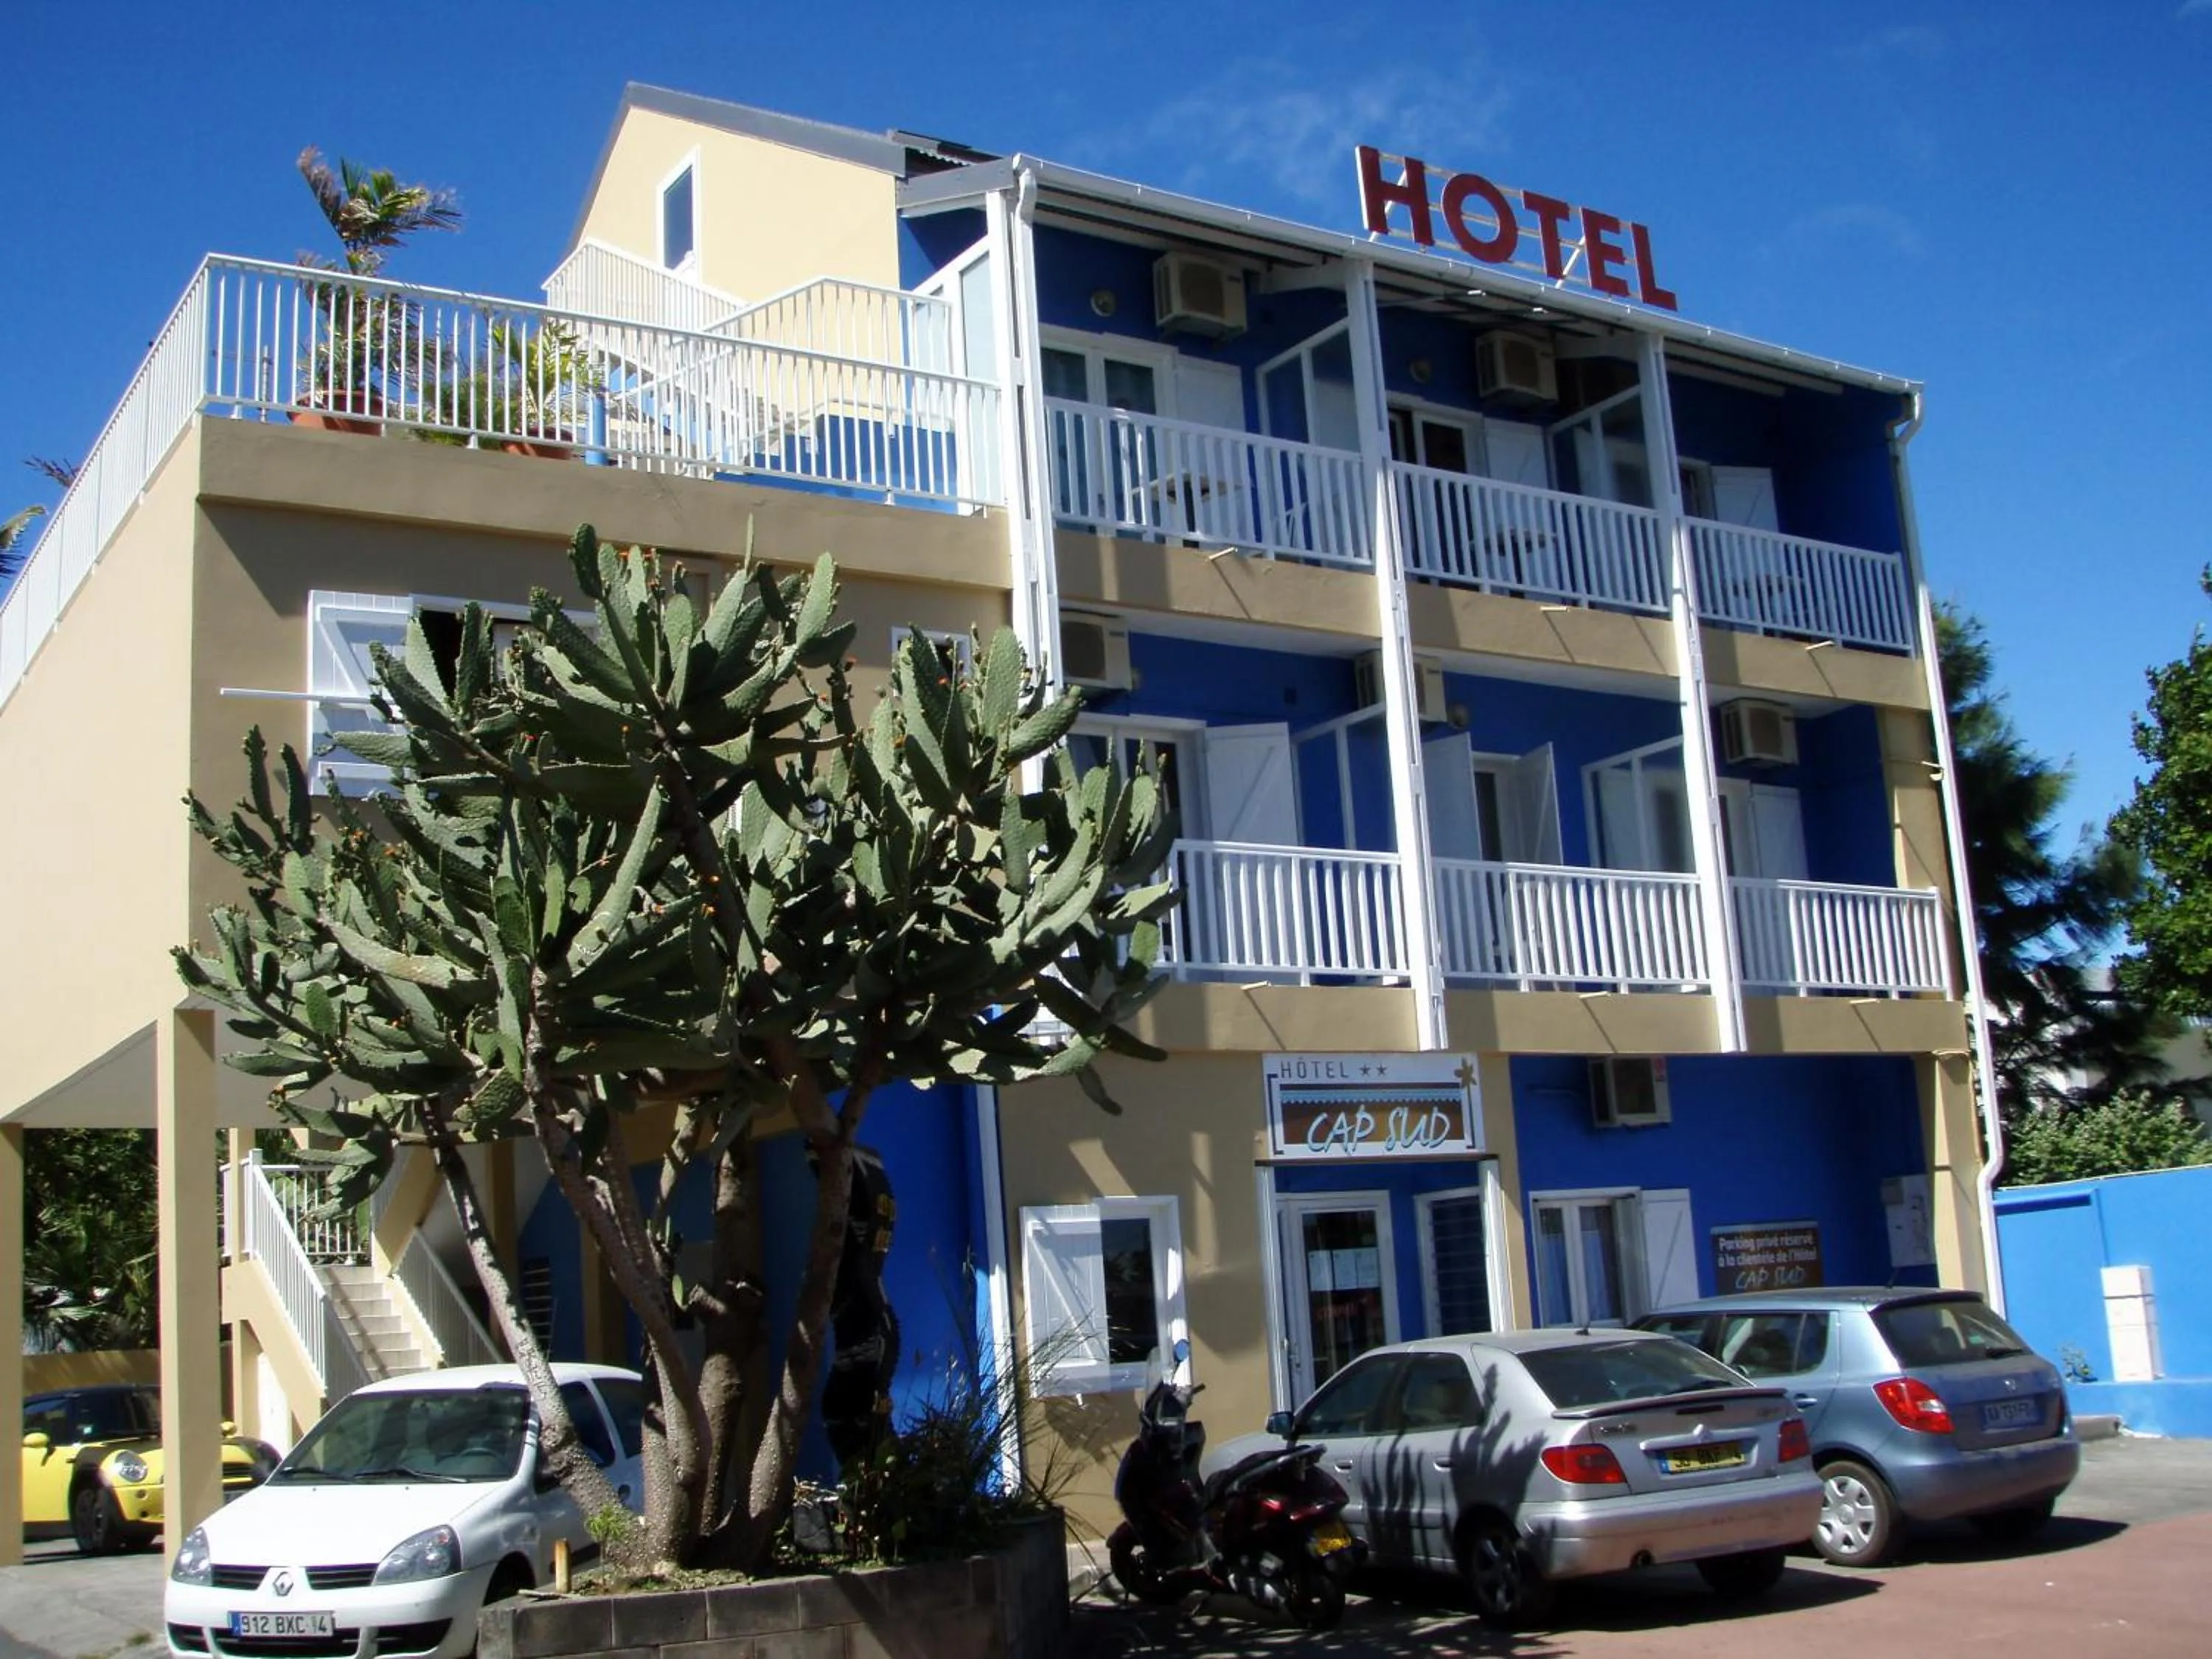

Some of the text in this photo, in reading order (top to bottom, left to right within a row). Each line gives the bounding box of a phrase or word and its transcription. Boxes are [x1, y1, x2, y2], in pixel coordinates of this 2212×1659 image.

[1355, 145, 1678, 312] HOTEL
[1281, 1057, 1349, 1079] HÔTEL
[1307, 1105, 1451, 1155] CAP SUD
[1735, 1266, 1805, 1290] CAP SUD
[241, 1615, 270, 1633] 912
[275, 1615, 306, 1633] BXC
